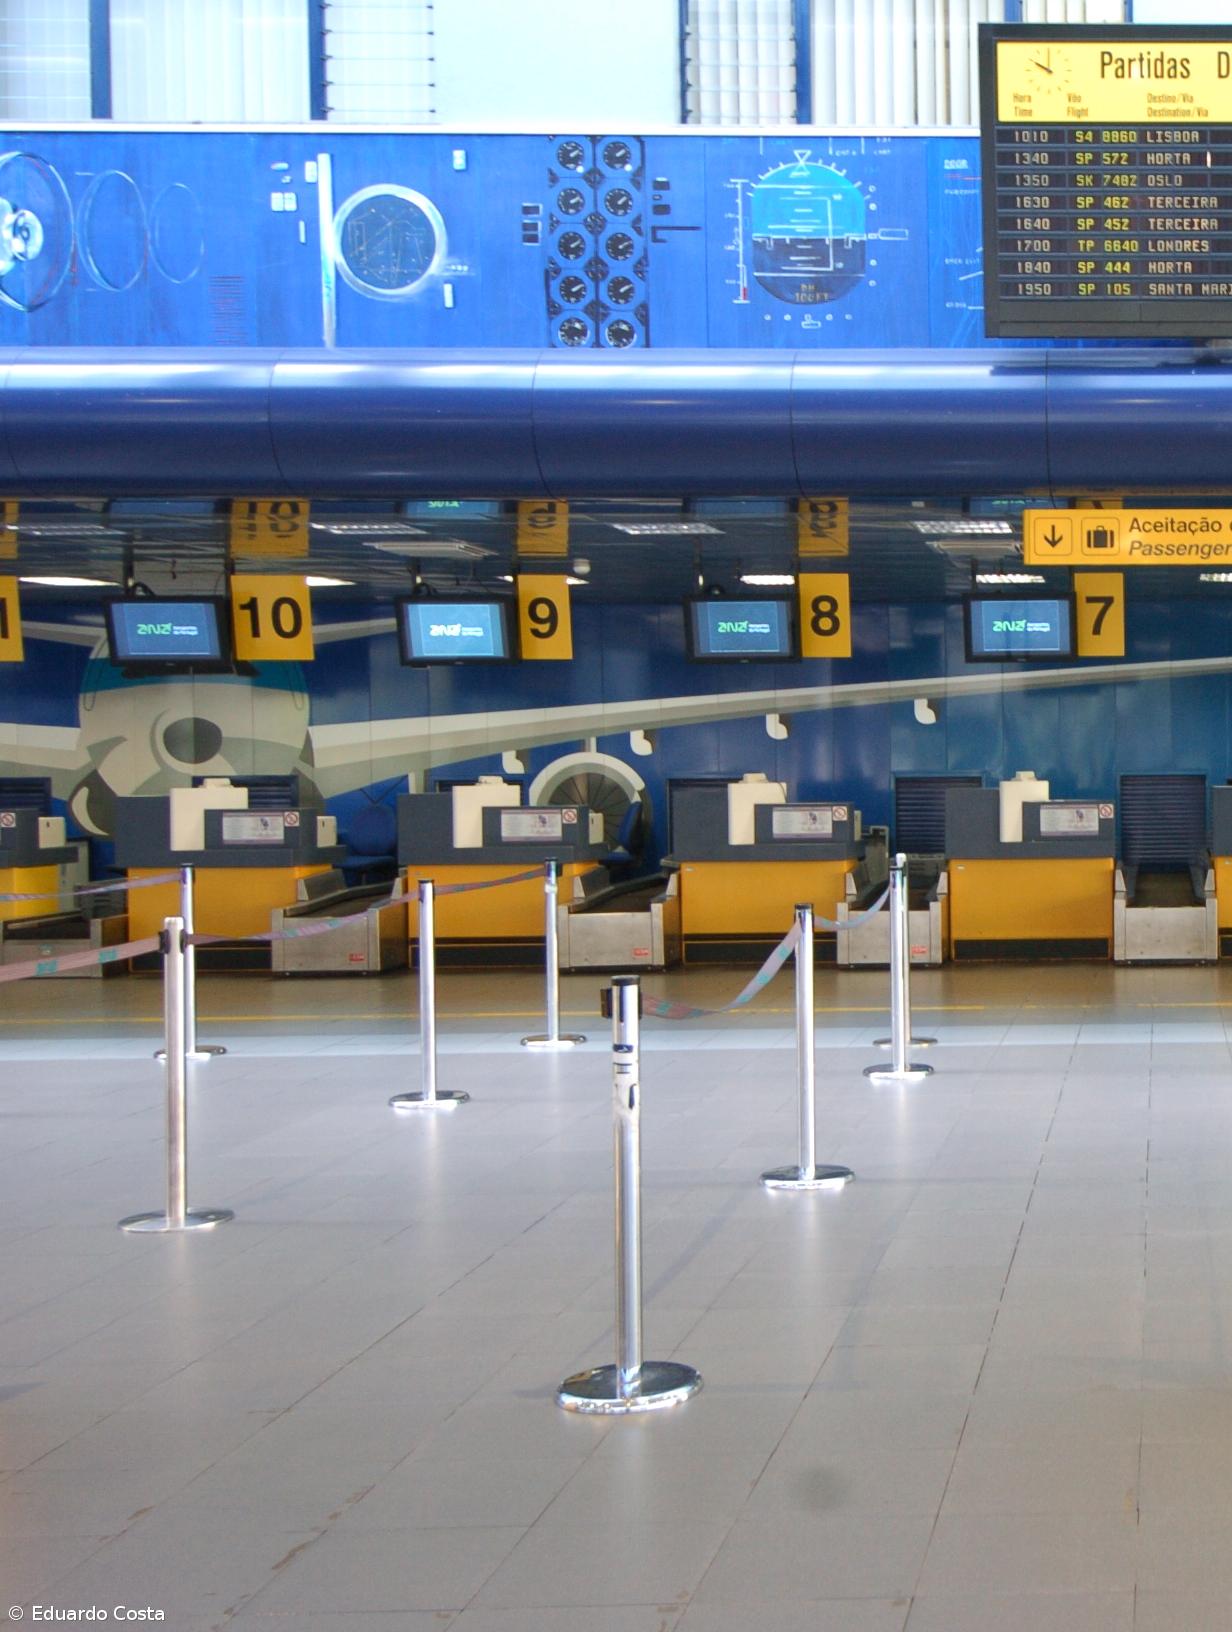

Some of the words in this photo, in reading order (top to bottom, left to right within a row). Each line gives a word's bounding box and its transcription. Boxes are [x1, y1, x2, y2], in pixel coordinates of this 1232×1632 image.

[1100, 51, 1191, 79] Partidas
[1013, 93, 1032, 103] Hora
[1014, 107, 1032, 117] Time
[1067, 107, 1089, 118] Flight
[1015, 131, 1048, 143] 1010
[1147, 131, 1199, 143] LISBOA
[1015, 153, 1048, 165] 1340
[1076, 153, 1092, 165] SP
[1103, 153, 1128, 165] 572
[1147, 153, 1190, 165] HORTA
[1016, 175, 1049, 187] 1350
[1077, 175, 1093, 187] SK
[1148, 175, 1182, 187] OSLO
[1016, 197, 1049, 209] 1630
[1077, 197, 1094, 209] SP
[1104, 197, 1129, 209] 462
[1148, 197, 1218, 209] TERCEIRA
[1017, 218, 1050, 231] 1640
[1077, 218, 1094, 231] SP
[1104, 218, 1129, 231] 452
[1149, 218, 1218, 231] TERCEIRA
[1017, 240, 1050, 252] 1700
[1078, 240, 1094, 252] TP
[1104, 240, 1138, 252] 6640
[1149, 240, 1209, 252] LONDRES
[1018, 262, 1051, 274] 1840
[1078, 262, 1095, 274] SP
[1105, 262, 1130, 274] 444
[1149, 262, 1192, 274] HORTA
[1018, 284, 1051, 296] 1950
[1079, 284, 1095, 296] SP
[1107, 284, 1130, 296] 105
[1149, 284, 1192, 296] SANTA
[1129, 516, 1222, 536] Aceitação
[239, 597, 302, 638] 10
[528, 597, 559, 638] 9
[810, 595, 840, 637] 8
[1085, 596, 1115, 636] 7
